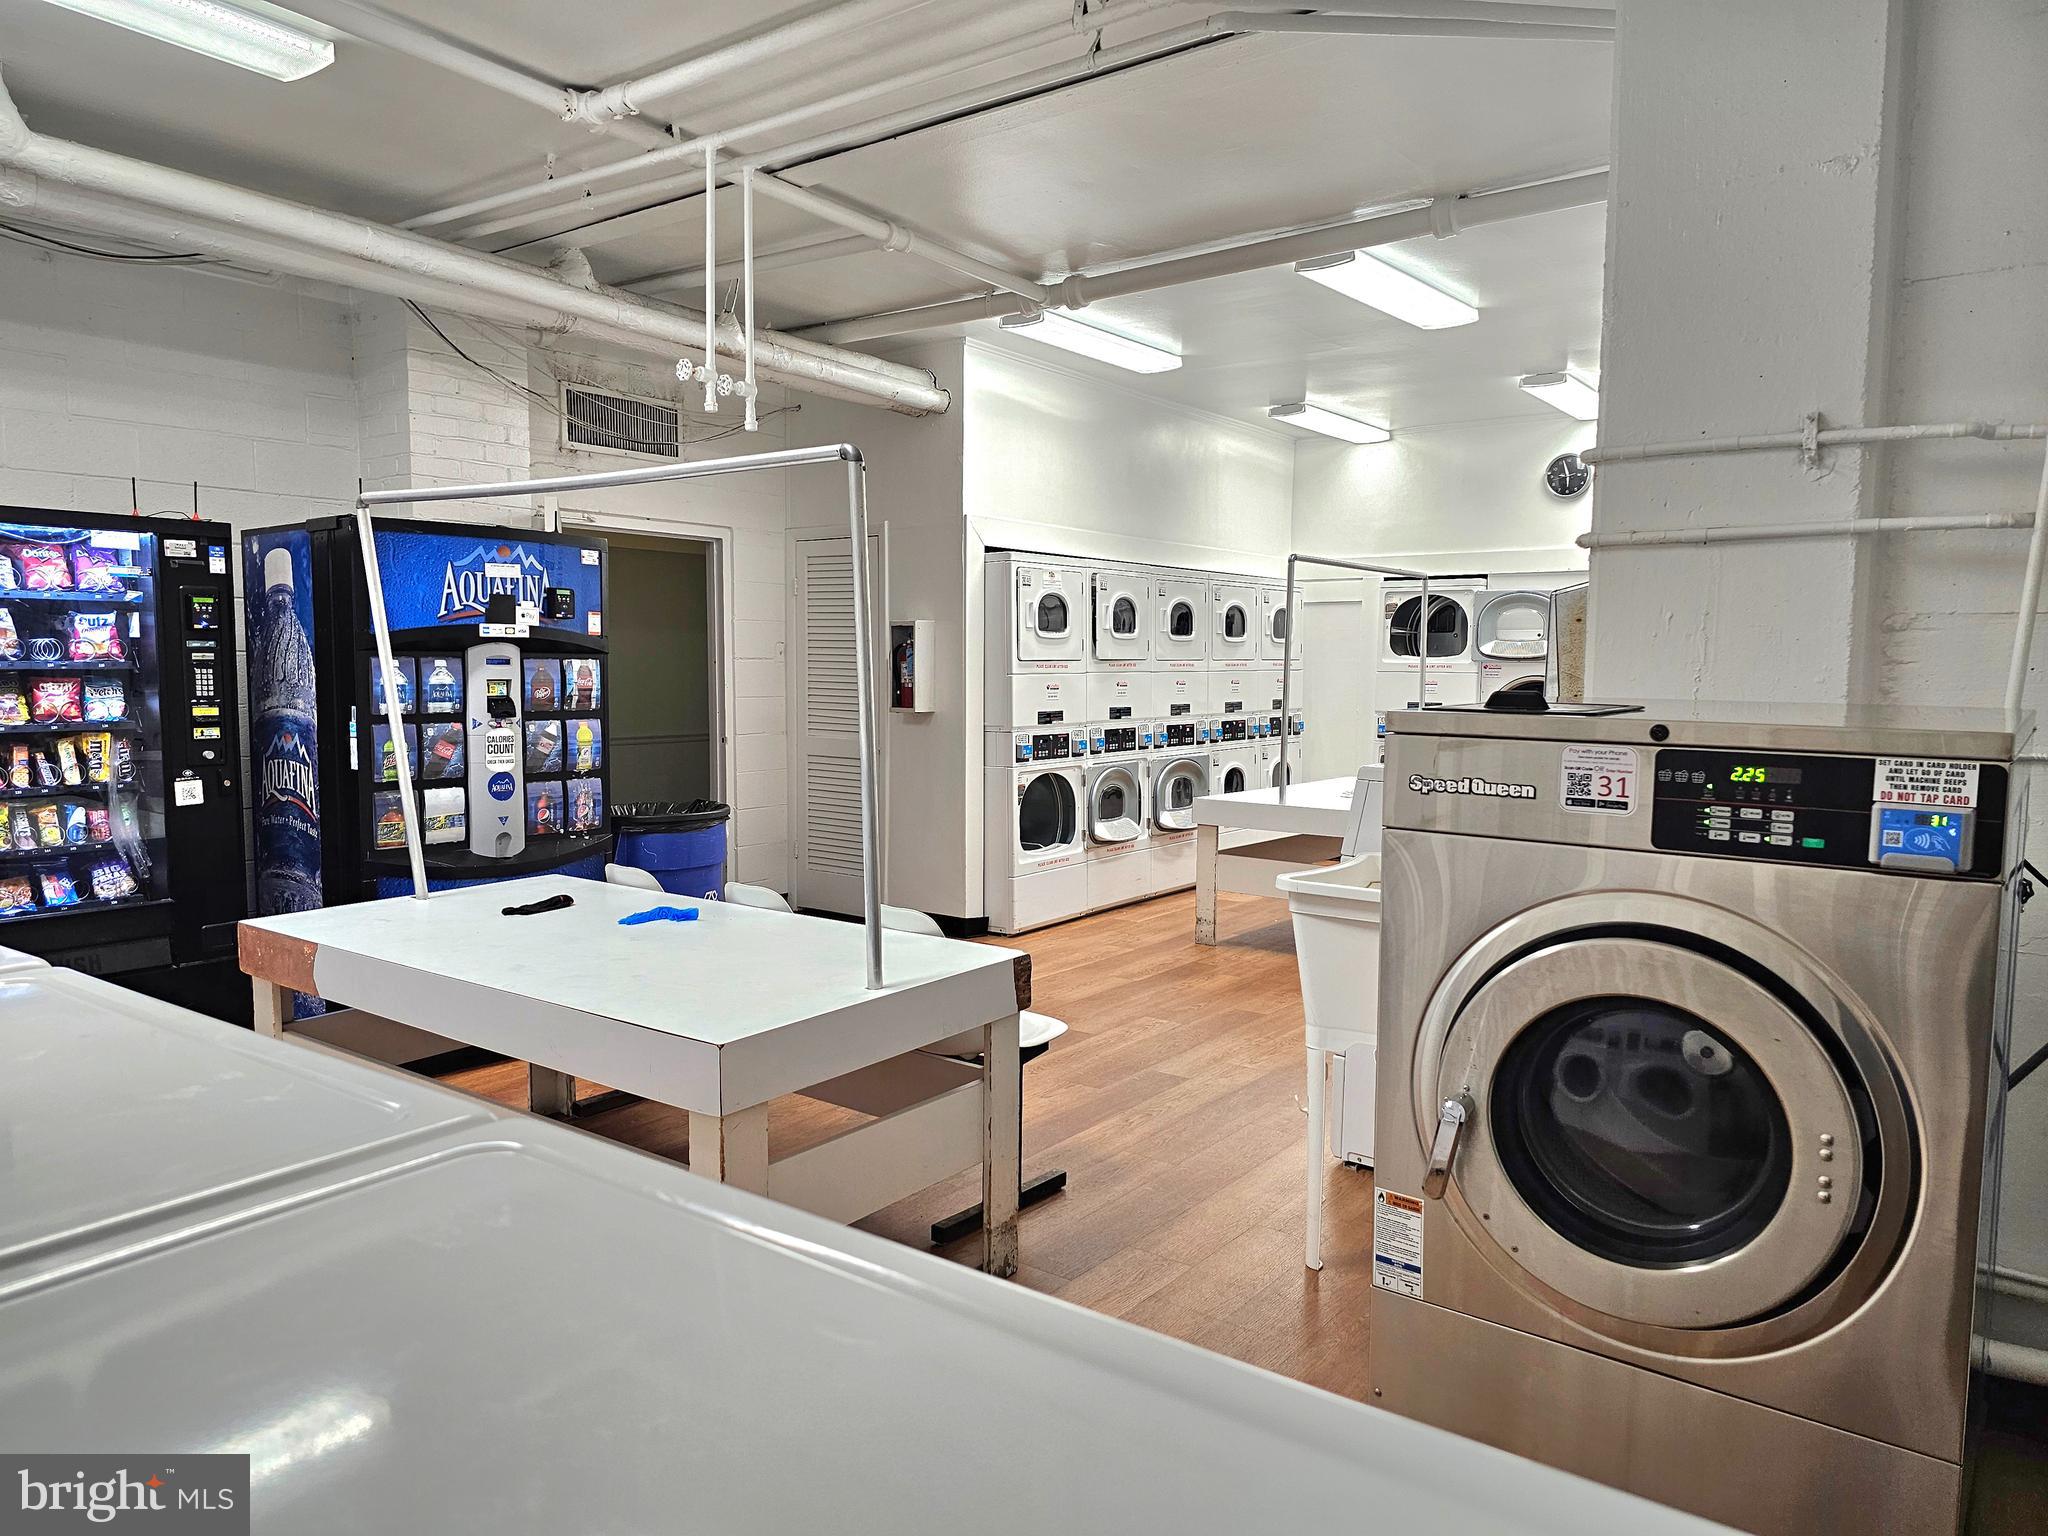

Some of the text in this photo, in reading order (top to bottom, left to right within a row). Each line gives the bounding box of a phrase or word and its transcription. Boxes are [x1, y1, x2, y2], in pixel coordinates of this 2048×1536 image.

[487, 735, 515, 744] CALORIES
[487, 743, 515, 755] COUNT
[1878, 759, 1978, 771] SET CARD IN CARD HOLDER
[1731, 767, 1765, 783] 2.25
[1885, 775, 1968, 786] UNTIL MACHINE BEEPS
[1945, 770, 1966, 778] CARD
[261, 753, 318, 819] AQUAFINA
[1409, 774, 1537, 799] Speed Queen
[1598, 775, 1630, 799] 31
[1890, 783, 1963, 794] THEN REMOVE CARD
[1880, 790, 1971, 806] DO NOT TAP CARD
[289, 815, 307, 832] Perfect
[1931, 814, 1948, 828] 31
[94, 865, 121, 879] BIG
[93, 871, 127, 888] TEXAS
